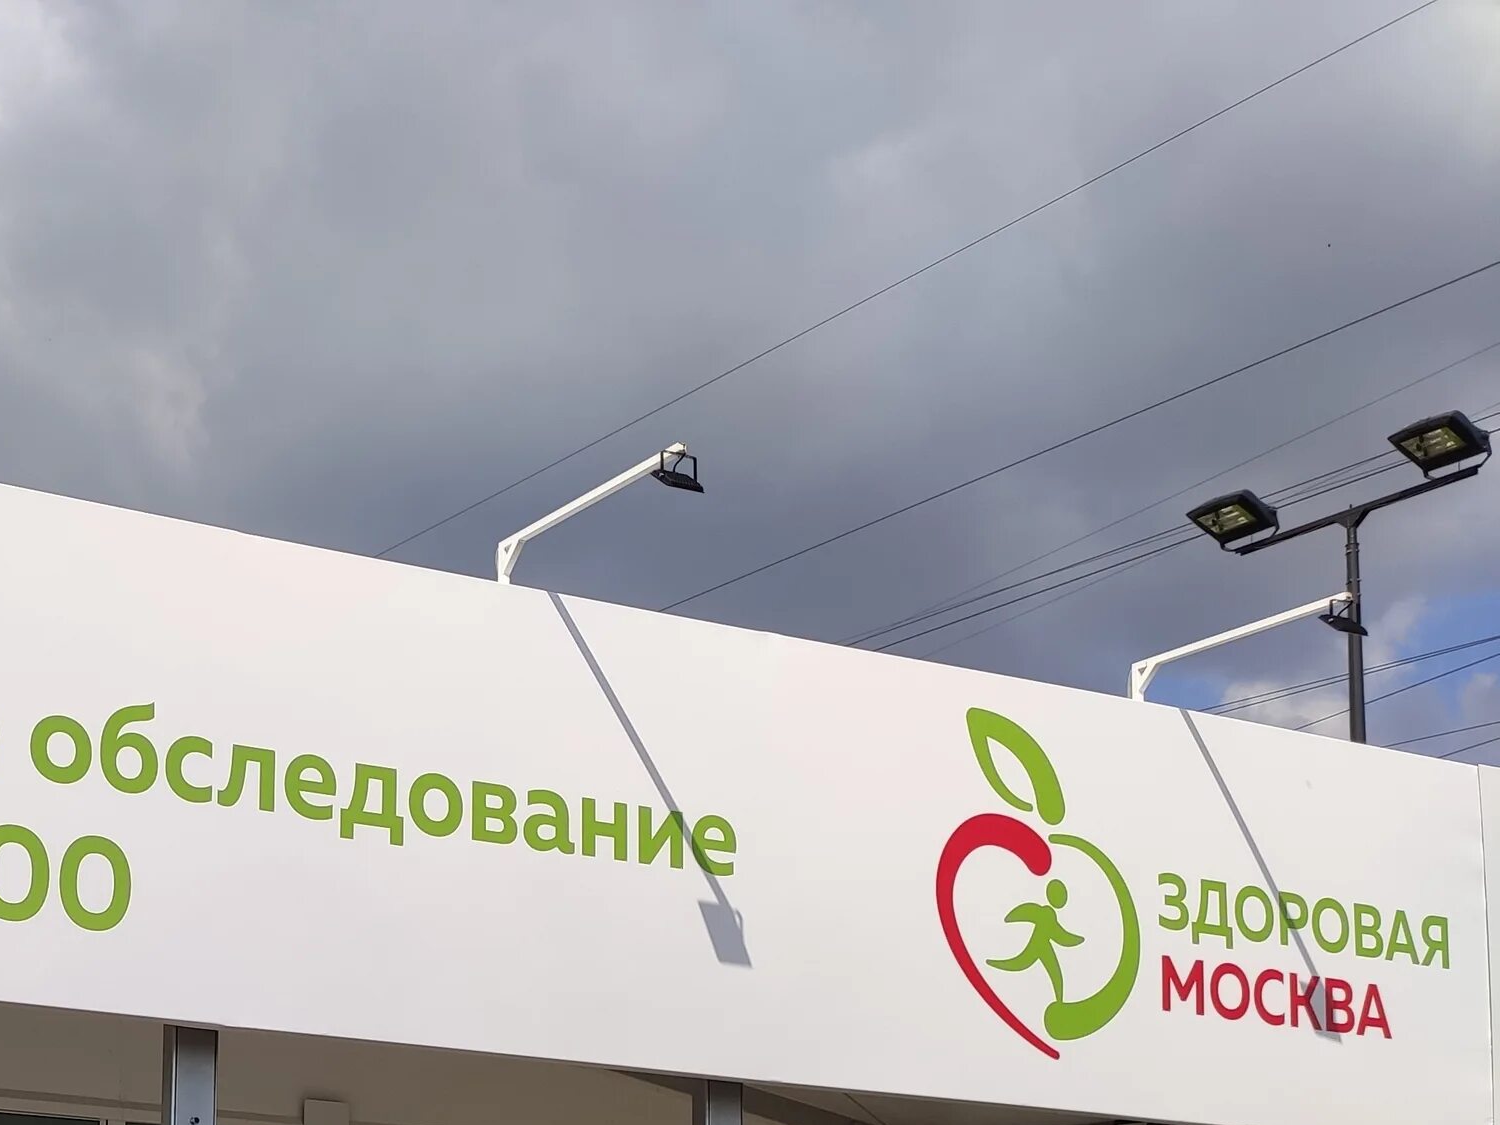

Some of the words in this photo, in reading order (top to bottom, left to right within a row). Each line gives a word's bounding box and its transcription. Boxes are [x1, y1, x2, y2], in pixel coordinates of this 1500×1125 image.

[29, 703, 737, 879] обследование
[1157, 872, 1451, 969] ЗДОРОВАЯ
[1160, 955, 1393, 1040] МОСКВА
